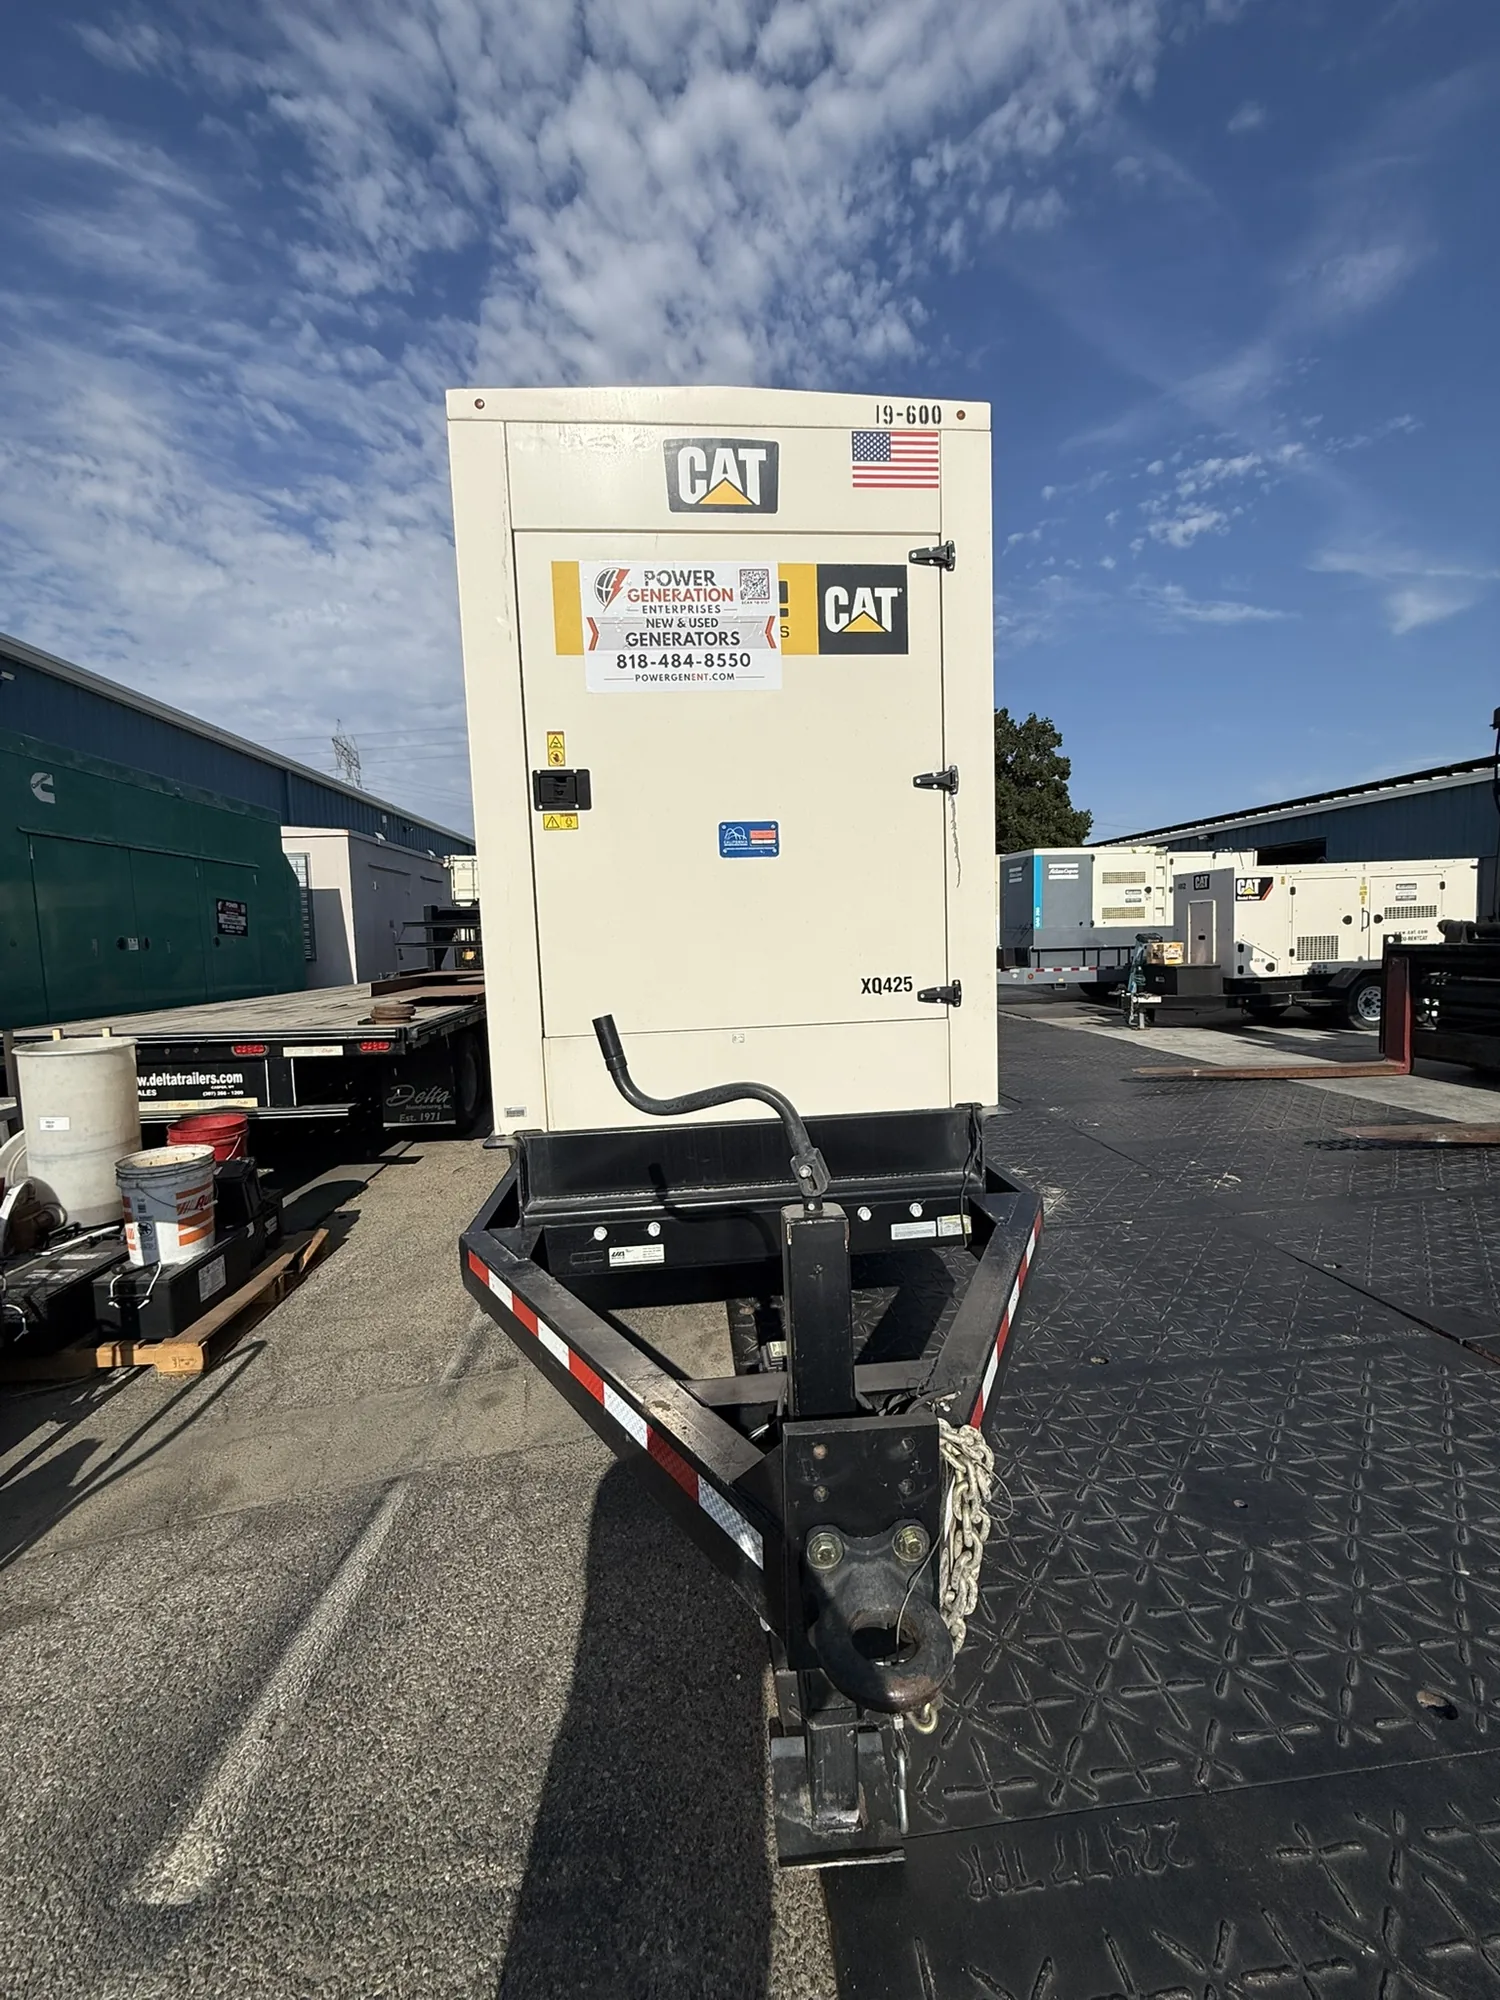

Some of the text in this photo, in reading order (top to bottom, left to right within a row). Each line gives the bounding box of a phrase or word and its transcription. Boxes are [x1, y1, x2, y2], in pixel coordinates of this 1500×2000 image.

[875, 404, 943, 425] 19-600
[677, 444, 767, 505] CAT
[644, 569, 717, 587] POWER
[627, 587, 734, 603] GENERATION
[642, 604, 721, 614] ENTERPRISES
[825, 585, 896, 633] CAT
[646, 617, 719, 628] NEW & USED
[626, 631, 741, 647] GENERATORS
[616, 652, 751, 669] 818-484-8550
[635, 673, 735, 682] POWERGENENT.COM
[1194, 875, 1209, 889] CAT
[1236, 878, 1261, 895] CAT
[861, 976, 914, 996] XQ425
[136, 1072, 243, 1086] w.deltatrailers.com
[385, 1084, 451, 1107] Delta
[399, 1112, 440, 1122] Est. 1971
